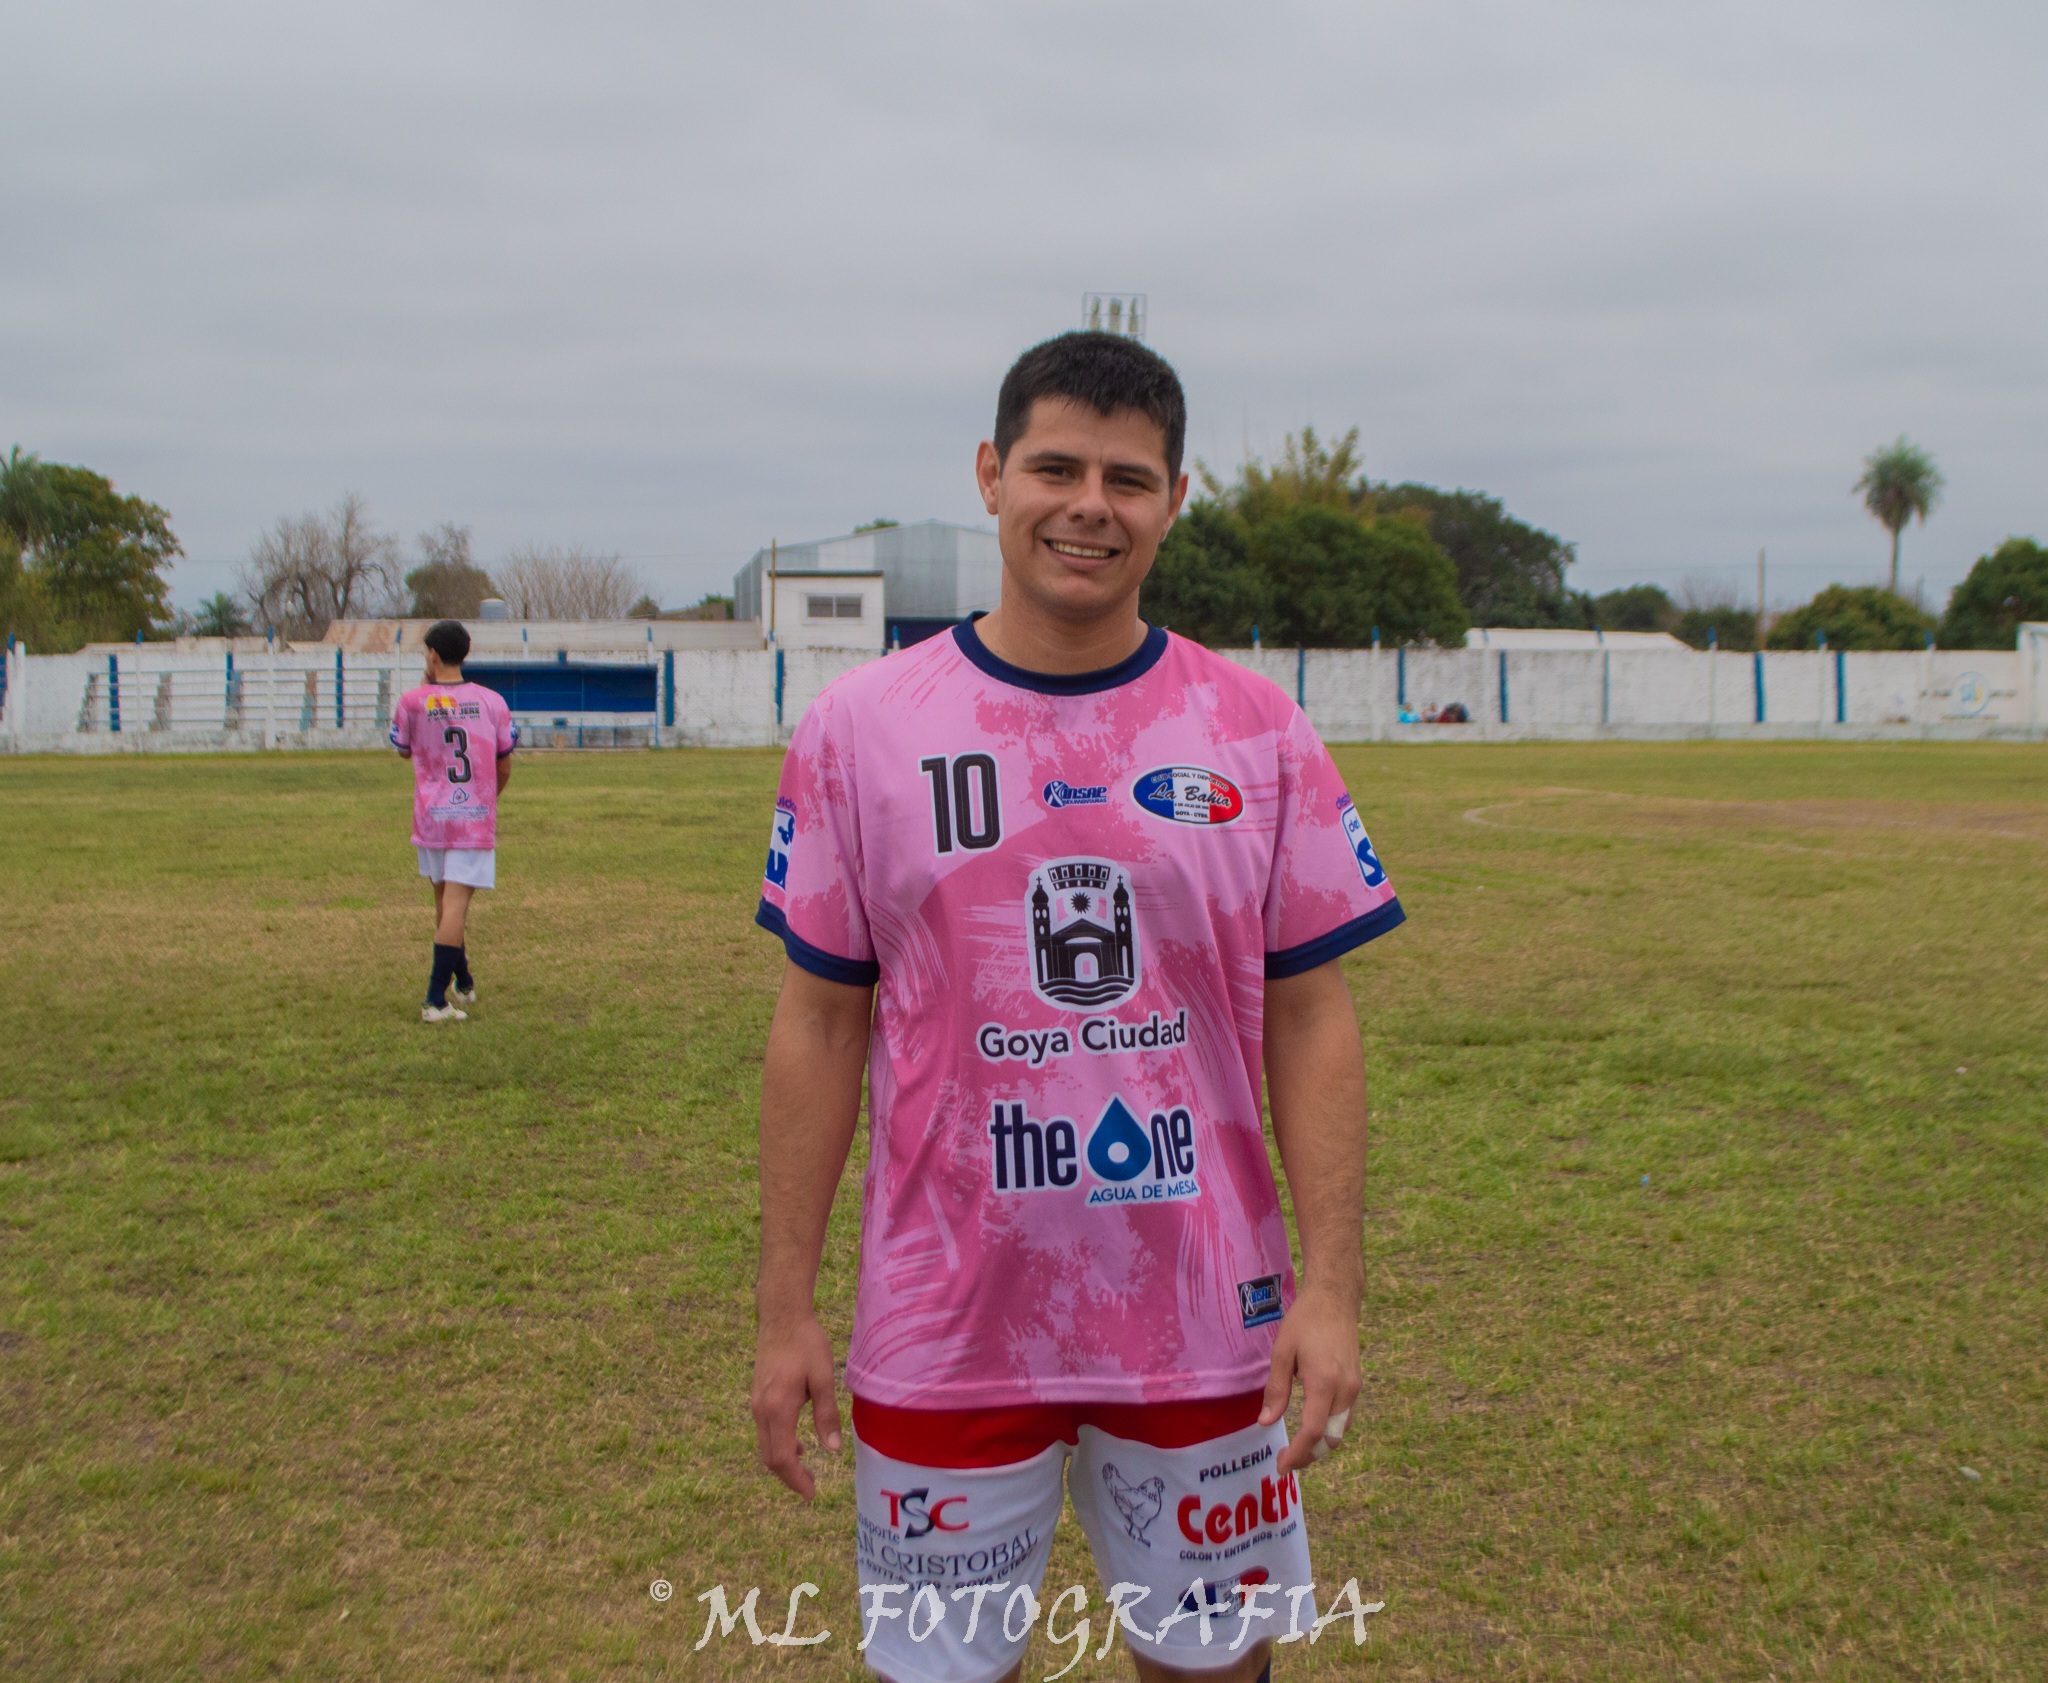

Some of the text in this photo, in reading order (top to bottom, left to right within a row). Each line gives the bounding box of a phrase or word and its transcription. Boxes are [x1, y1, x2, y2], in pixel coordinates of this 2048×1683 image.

[427, 708, 448, 717] JOSE
[459, 707, 480, 715] JERE
[444, 726, 471, 783] 3
[921, 753, 1000, 853] 10
[1149, 782, 1177, 800] La
[1151, 773, 1168, 784] CLUB
[1197, 774, 1229, 791] DEPORTIVO
[980, 1011, 1186, 1064] Goya Ciudad
[990, 1103, 1078, 1189] the
[1089, 1179, 1198, 1203] AGUA DE MESA
[1200, 1444, 1273, 1482] POLLERIA
[880, 1487, 970, 1538] TSC
[881, 1527, 1038, 1578] CRISTOBAL
[1180, 1519, 1297, 1561] COLON Y ENTRE RIOS GOYA
